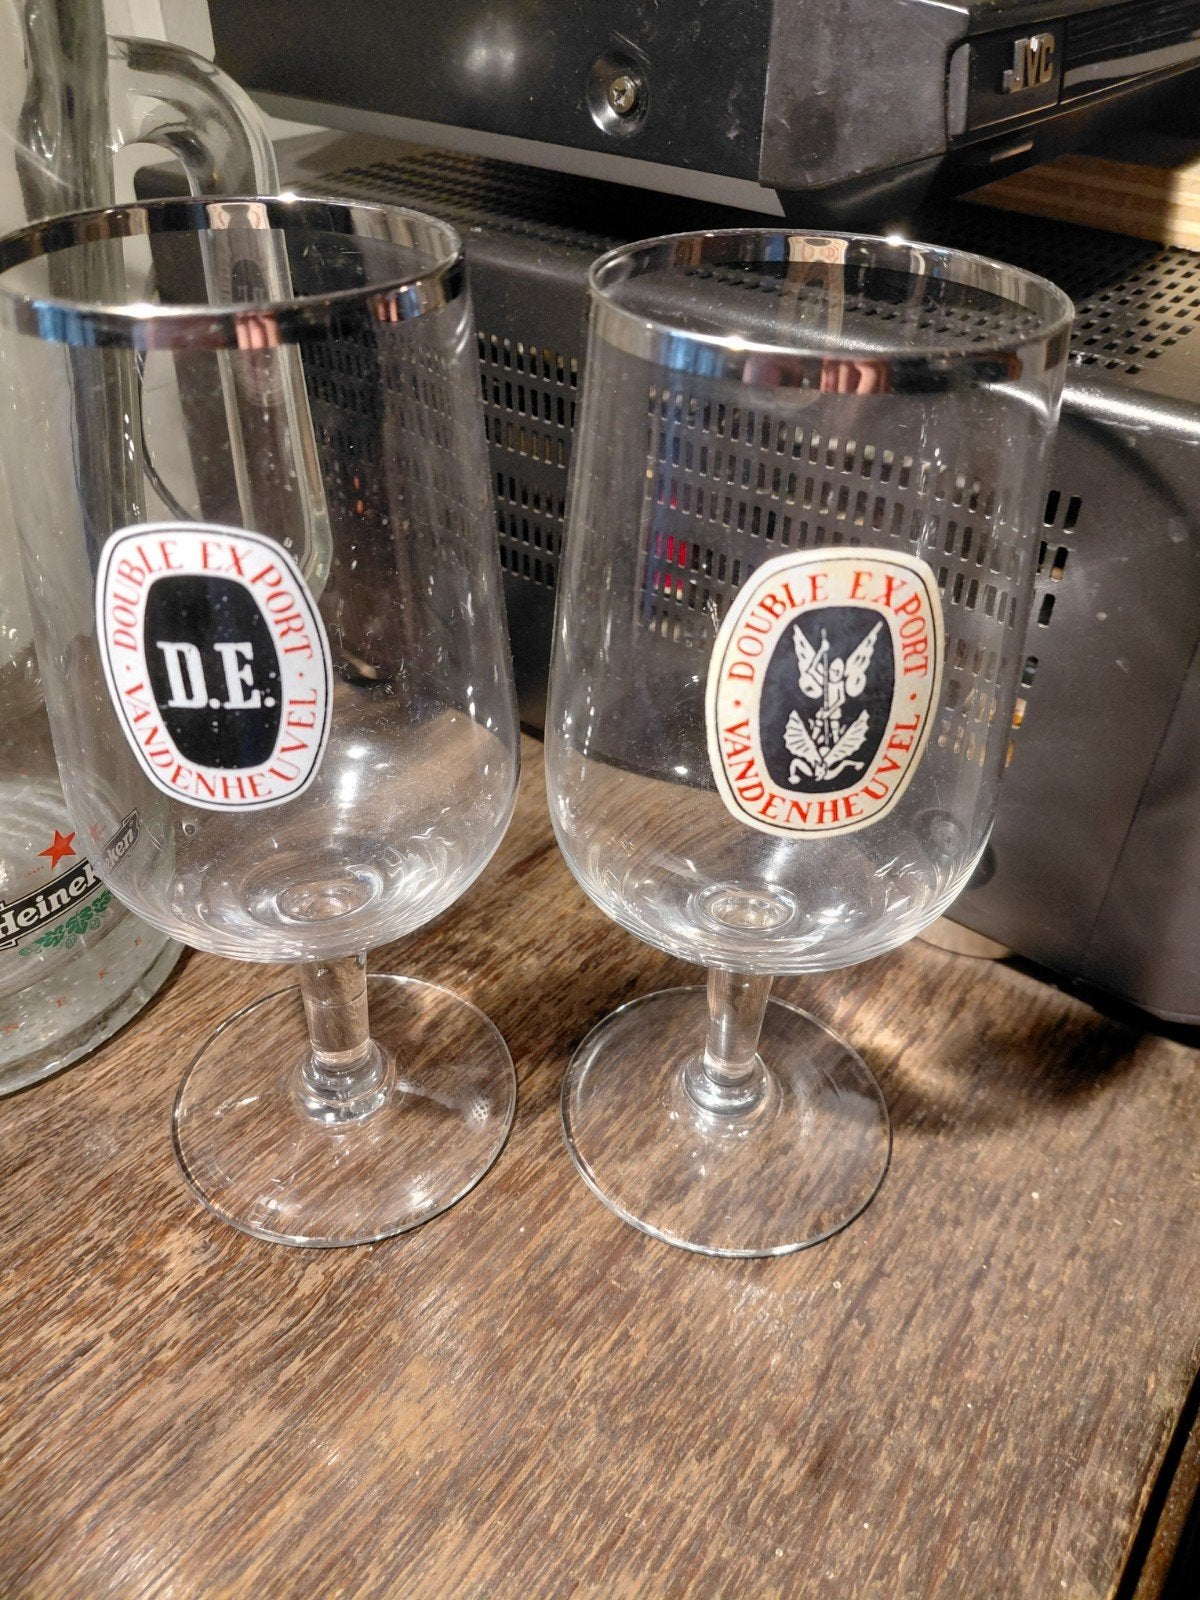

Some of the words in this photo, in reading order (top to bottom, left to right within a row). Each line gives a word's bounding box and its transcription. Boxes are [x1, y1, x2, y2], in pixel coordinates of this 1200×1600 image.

[1003, 33, 1055, 93] JVC
[112, 540, 184, 652] DOUBLE
[200, 540, 314, 661] EXPORT
[729, 573, 828, 682] DOUBLE
[850, 571, 928, 679] EXPORT
[156, 641, 276, 709] D.E.
[124, 682, 318, 799] VANDENHEUVEL
[724, 714, 920, 825] VANDENHEUVEL
